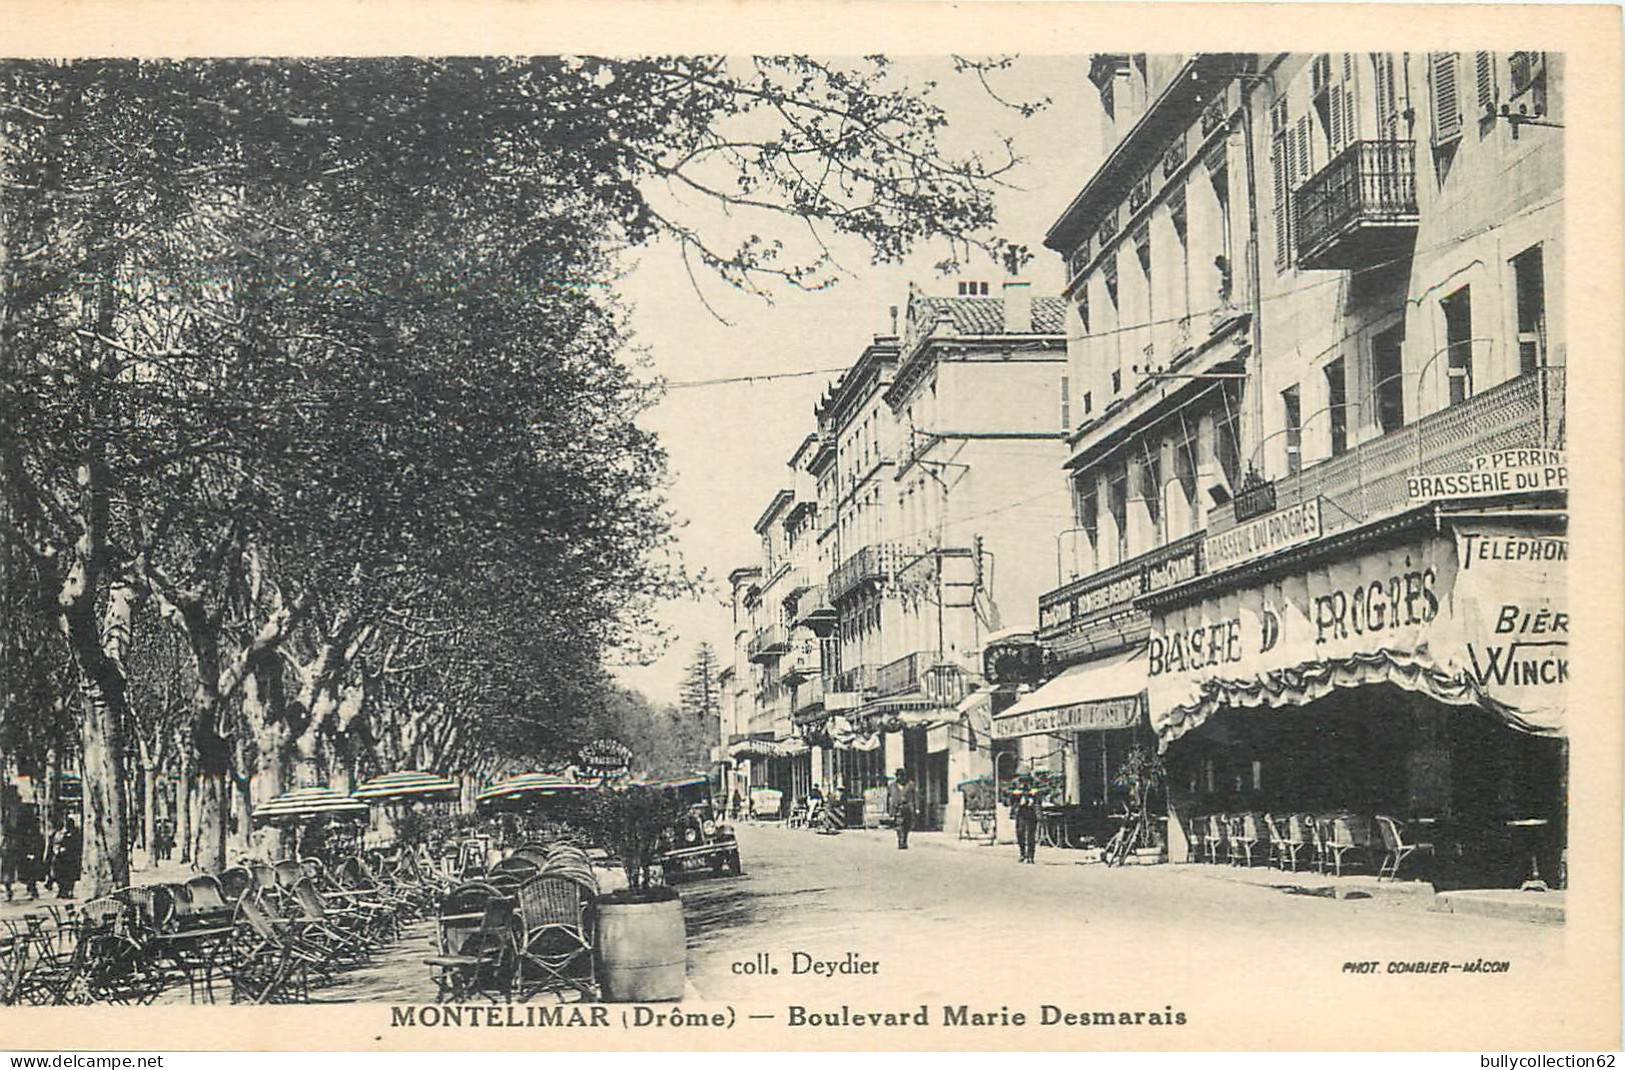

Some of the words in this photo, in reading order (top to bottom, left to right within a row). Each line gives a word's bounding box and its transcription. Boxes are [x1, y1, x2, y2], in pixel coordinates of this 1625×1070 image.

[1492, 450, 1559, 468] PERRIN
[1407, 471, 1510, 498] BRASSERIE
[1516, 472, 1538, 489] DU
[1253, 519, 1267, 549] DU
